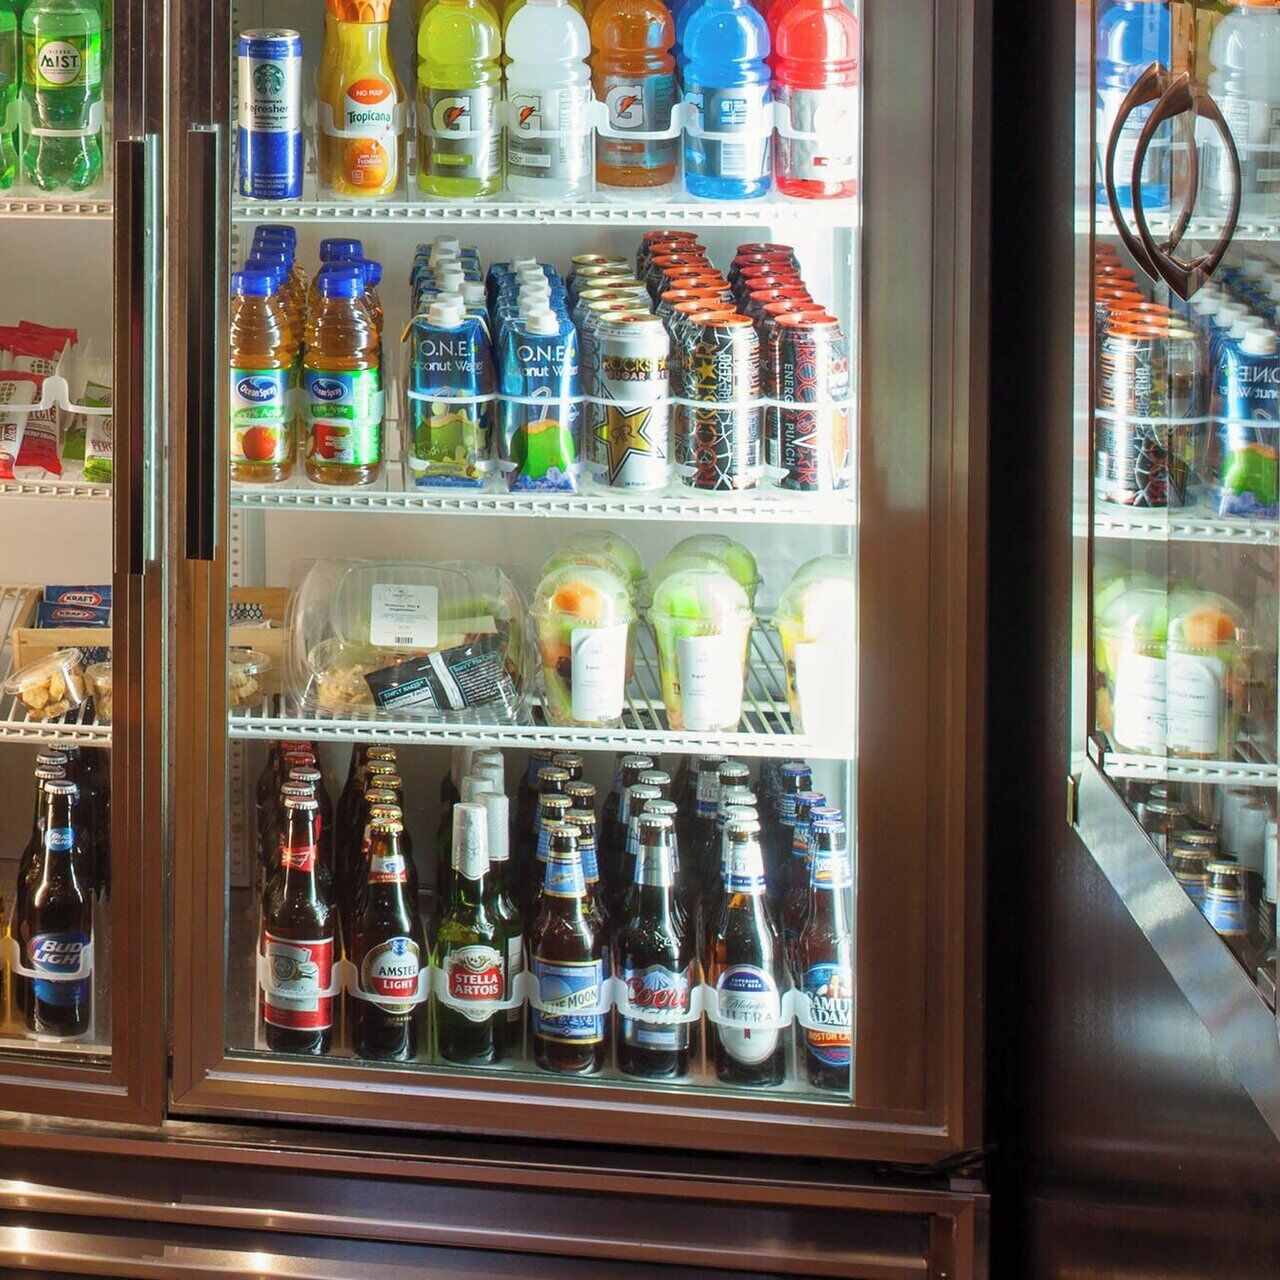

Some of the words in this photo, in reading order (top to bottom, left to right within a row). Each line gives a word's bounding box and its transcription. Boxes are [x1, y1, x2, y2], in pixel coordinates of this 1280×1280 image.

[40, 54, 80, 68] MIST
[355, 89, 368, 97] NO
[368, 88, 384, 96] PULP
[347, 110, 391, 124] Tropicana
[718, 354, 732, 383] ZERO
[239, 383, 259, 396] Ocean
[258, 382, 278, 399] Spray
[330, 405, 349, 416] Apple
[66, 595, 94, 603] KRAFT
[40, 940, 83, 953] BUD
[378, 966, 417, 977] AMSTEL
[383, 978, 414, 990] LIGHT
[454, 973, 499, 985] STELLA
[453, 983, 500, 995] ARTOIS
[567, 989, 598, 1009] MOON
[811, 1008, 851, 1026] ADAM
